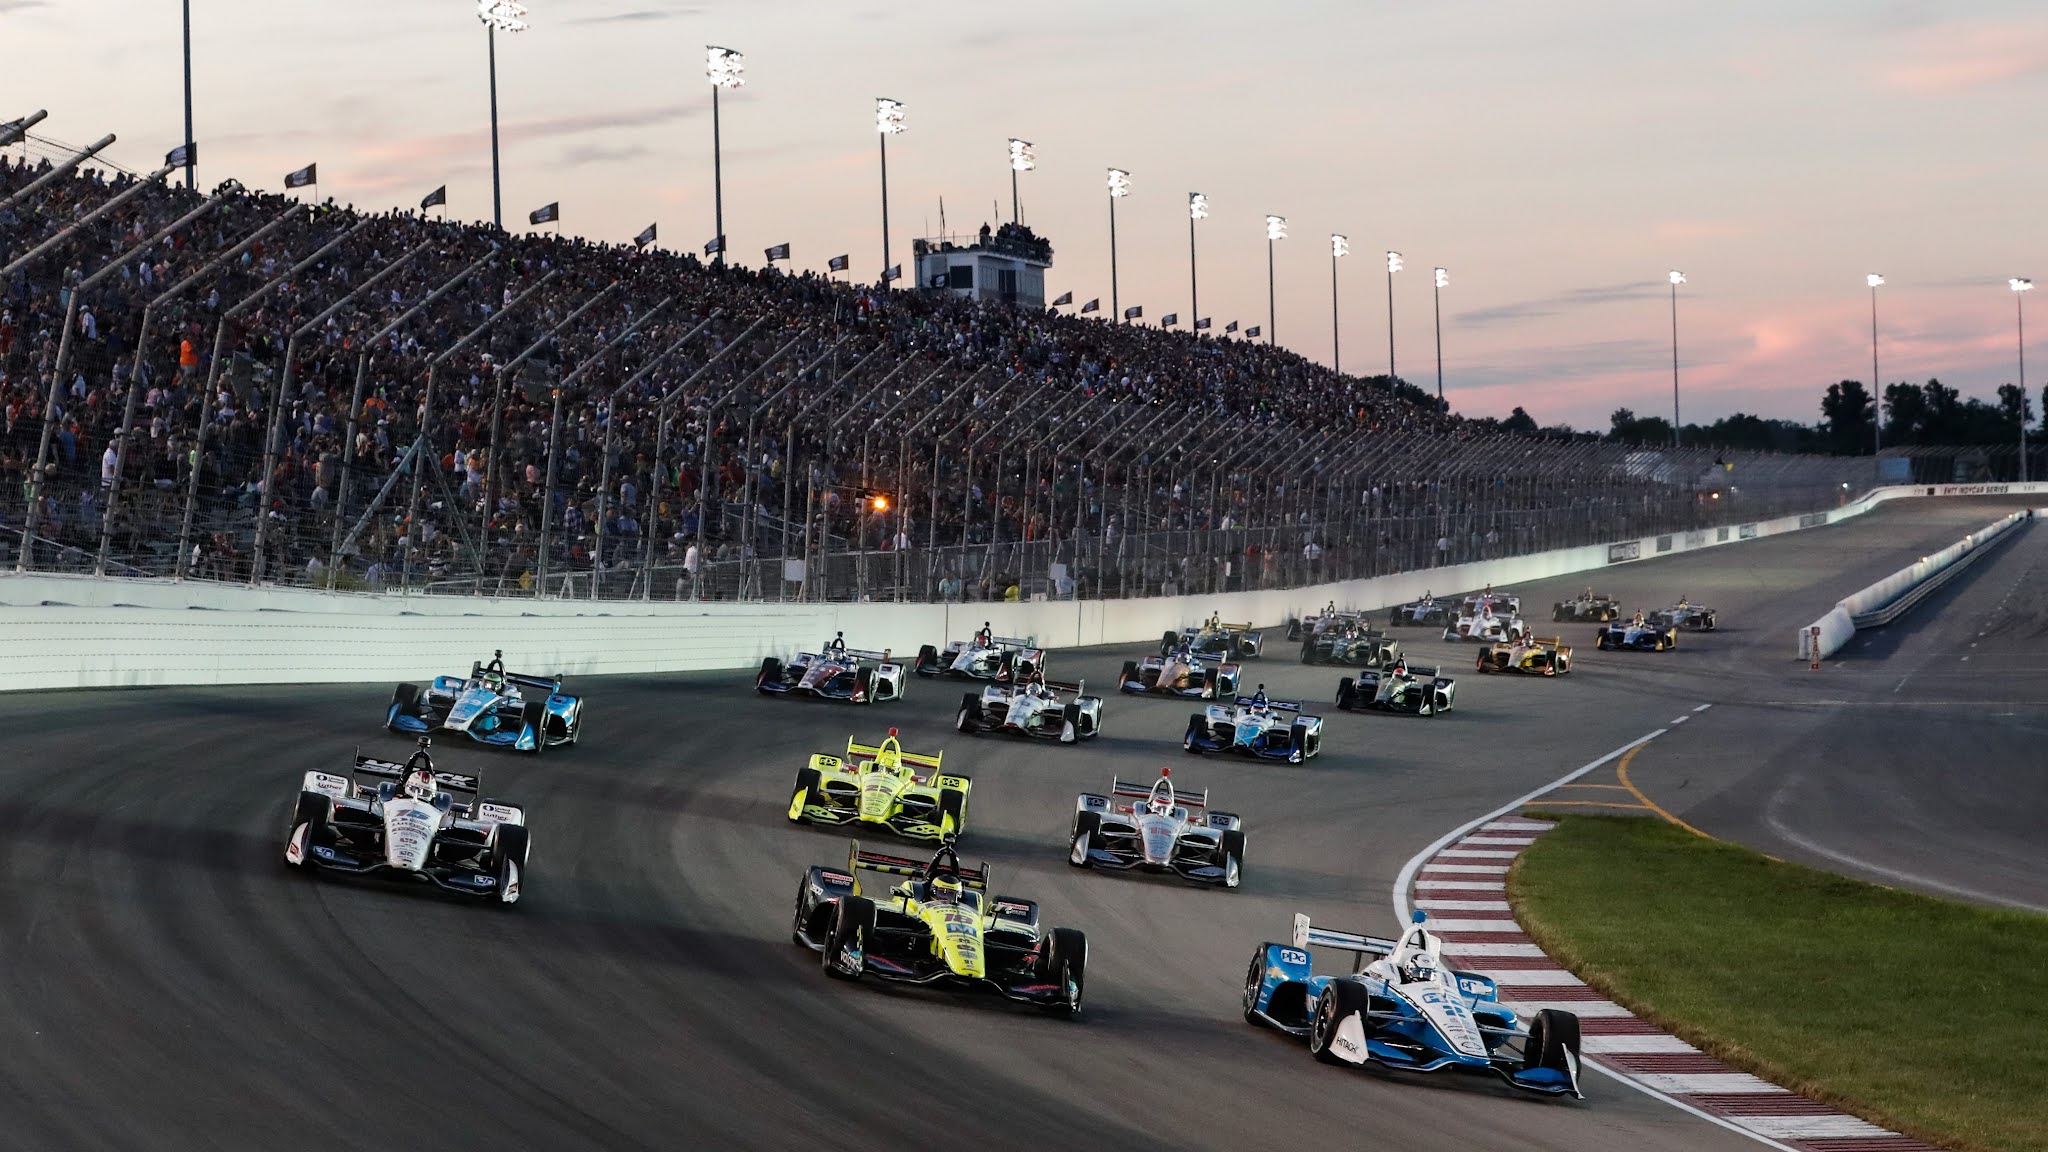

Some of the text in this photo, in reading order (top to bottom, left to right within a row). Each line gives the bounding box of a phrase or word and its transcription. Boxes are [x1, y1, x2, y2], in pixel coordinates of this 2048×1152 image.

[1959, 486, 1984, 495] INDYCAR
[1986, 485, 2009, 494] SERIES
[1282, 952, 1305, 963] PPG
